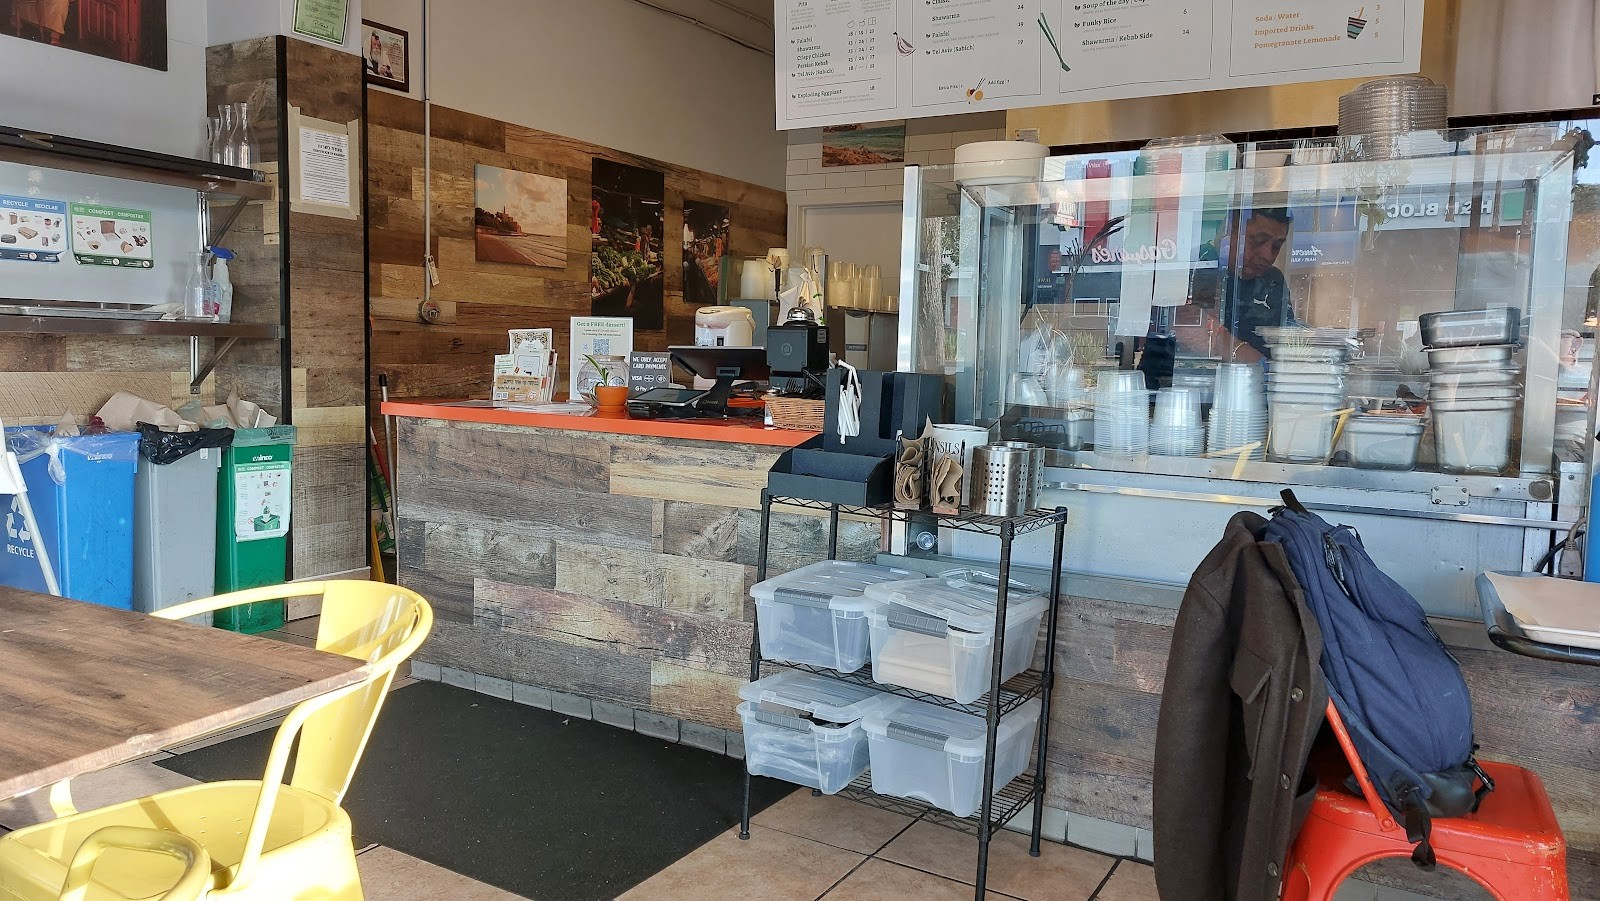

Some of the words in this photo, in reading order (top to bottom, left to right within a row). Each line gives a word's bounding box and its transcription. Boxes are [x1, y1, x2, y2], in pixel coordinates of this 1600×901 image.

[1082, 3, 1099, 11] Soup
[1082, 19, 1102, 27] Funky
[1255, 14, 1273, 22] Soda
[1278, 12, 1300, 20] Water
[932, 30, 950, 38] Falafel
[1254, 26, 1288, 36] Imported
[1290, 24, 1314, 32] Drinks
[1081, 36, 1115, 46] Shawarma
[1119, 33, 1139, 42] Kebab
[1139, 31, 1153, 39] Side
[1254, 38, 1302, 49] Pomegranate
[1303, 35, 1341, 44] Lemonade
[797, 54, 812, 62] Crispy
[3, 199, 29, 208] RECYCLE
[35, 203, 59, 211] RECICLAR
[88, 208, 114, 217] COMPOST
[117, 211, 145, 220] COMPOSTAR
[605, 321, 626, 329] dessert!
[934, 440, 962, 456] NSILS
[7, 544, 35, 559] RECYCLE
